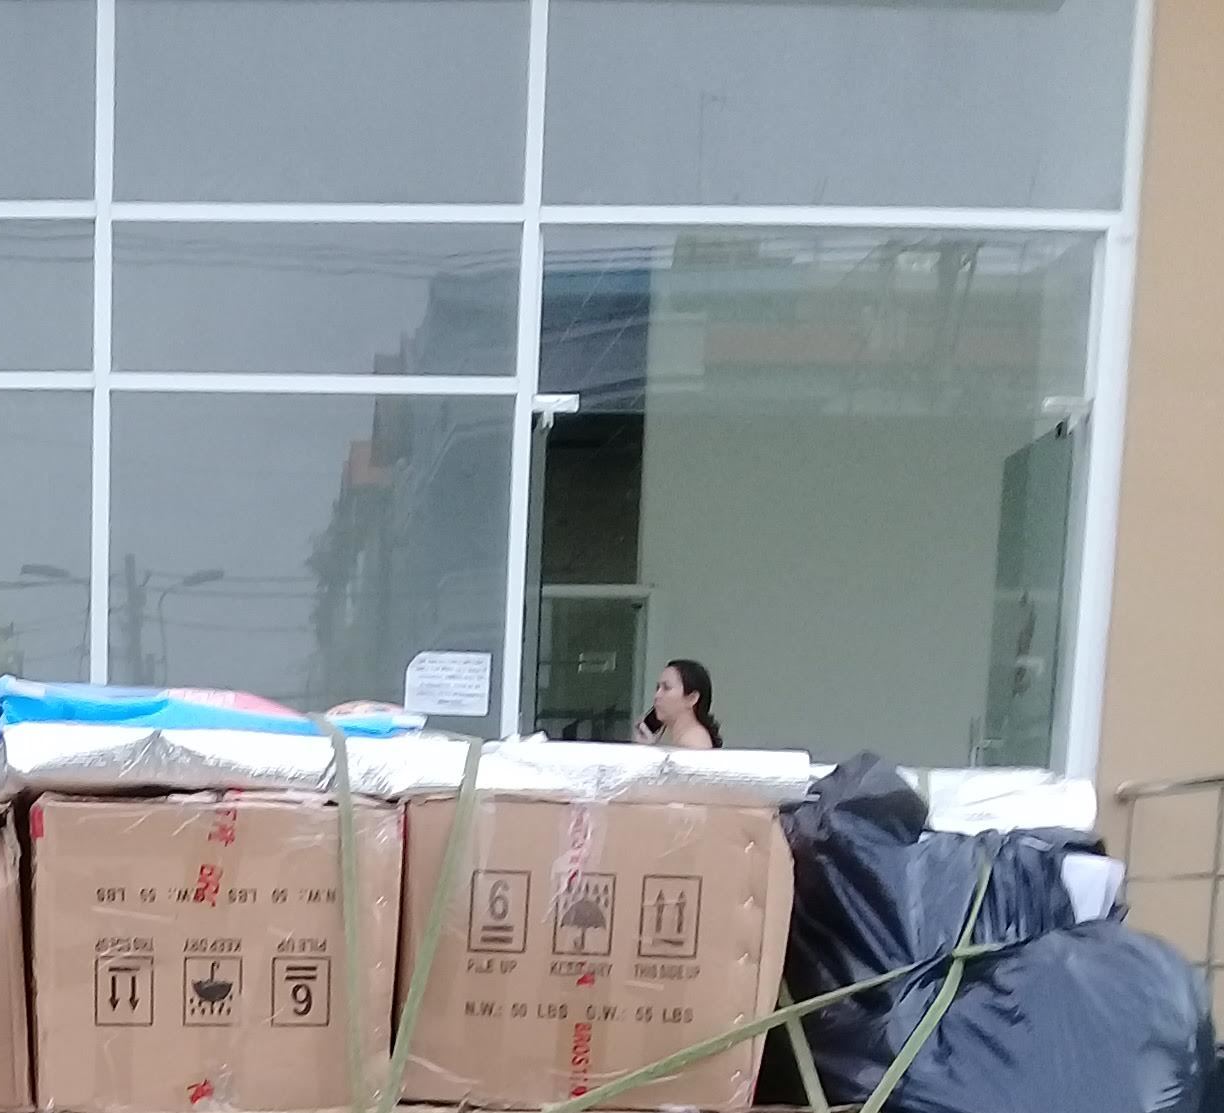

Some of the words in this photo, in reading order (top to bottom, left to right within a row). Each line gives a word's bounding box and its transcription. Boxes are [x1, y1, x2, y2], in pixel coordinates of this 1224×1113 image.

[488, 880, 511, 921] 6
[537, 1003, 568, 1019] LBS
[662, 1007, 695, 1023] LBS
